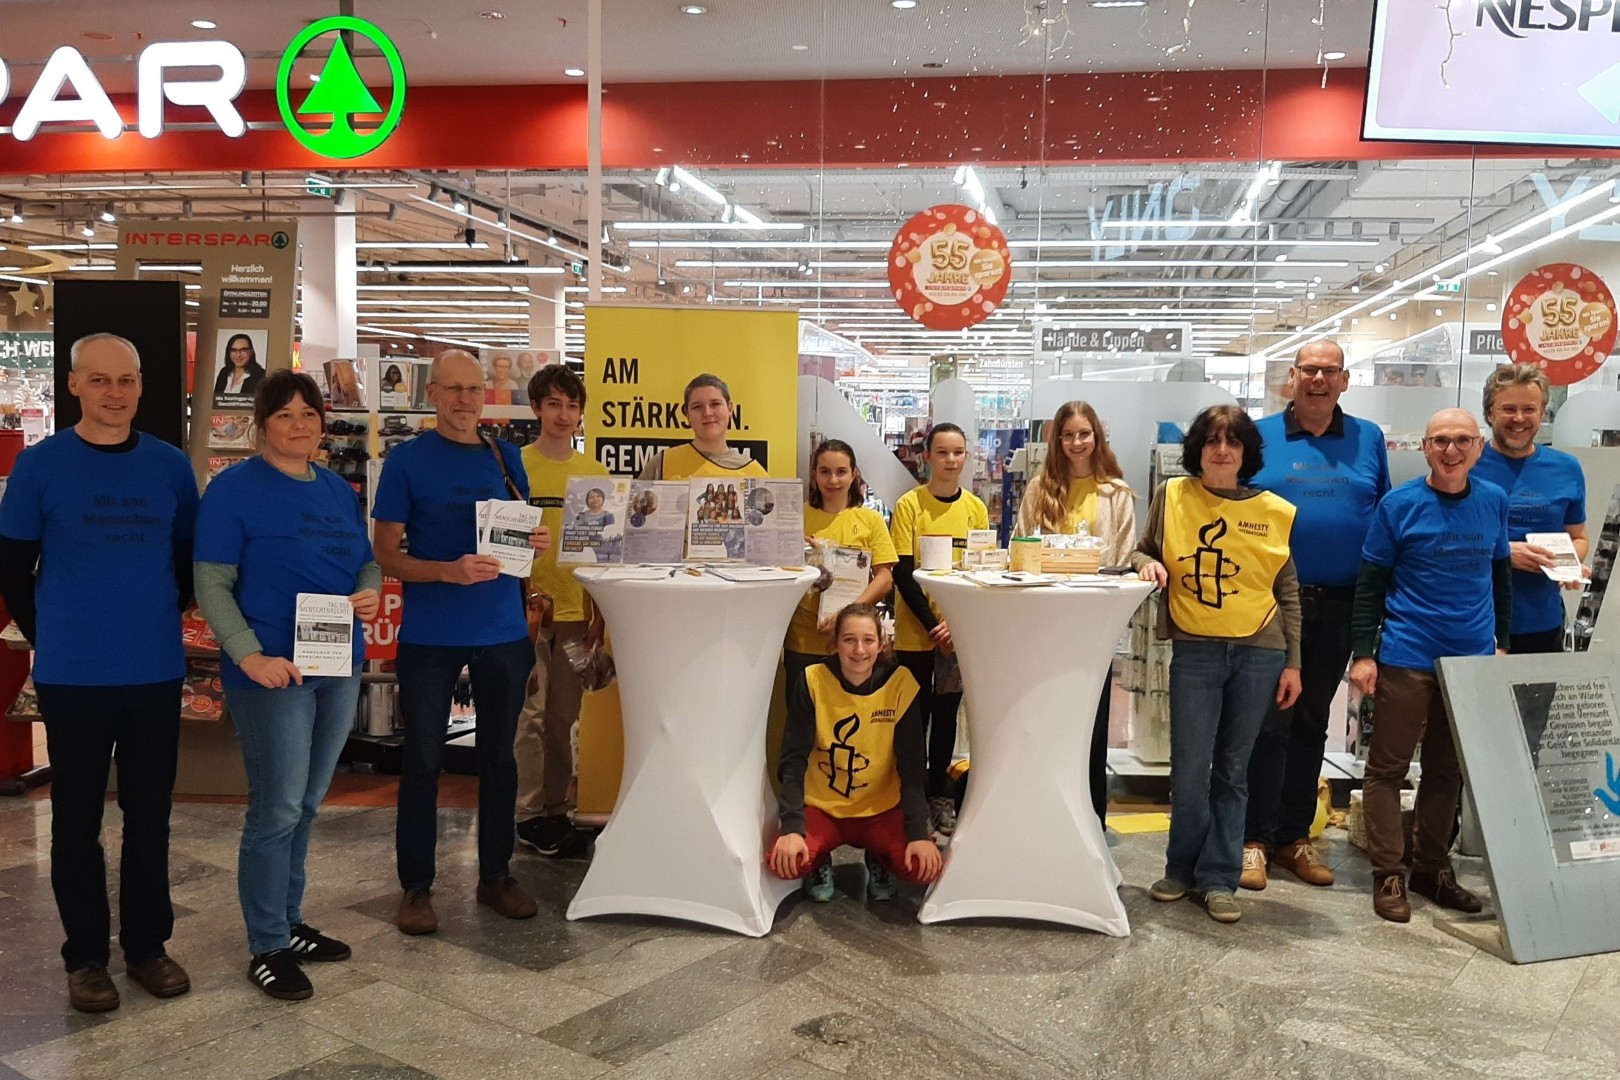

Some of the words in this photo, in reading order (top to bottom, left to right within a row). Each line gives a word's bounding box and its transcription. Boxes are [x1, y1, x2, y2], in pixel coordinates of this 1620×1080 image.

[1476, 0, 1620, 38] NESP
[0, 40, 248, 141] AR
[125, 232, 270, 247] INTERSPAR
[931, 239, 970, 270] 55
[231, 264, 265, 273] Herzlich
[974, 268, 1003, 280] sparen!
[221, 275, 273, 284] willkommen!
[926, 271, 970, 285] JAHRE
[1540, 297, 1578, 327] 55
[1583, 318, 1610, 332] sparen!
[1047, 332, 1087, 348] Hände
[1089, 333, 1100, 347] &
[1540, 327, 1580, 342] JAHRE
[1476, 334, 1506, 353] Pfle
[601, 357, 639, 385] AM
[601, 396, 749, 430] STÄRKSN.
[1302, 489, 1336, 498] recht
[93, 494, 116, 508] Mir
[121, 496, 148, 508] san
[83, 513, 161, 527] Menschen
[1238, 520, 1270, 532] AMNESTY
[105, 532, 145, 543] recht
[321, 546, 352, 556] recht
[299, 606, 350, 615] MENSCHENRECHTE
[339, 601, 350, 609] DER
[1556, 683, 1575, 692] chen
[1576, 682, 1591, 690] sind
[1593, 682, 1606, 691] frei
[1580, 691, 1604, 700] Würde
[870, 709, 897, 719] AMNESTY
[1562, 711, 1576, 720] mit
[1577, 709, 1610, 719] Vernunft
[1550, 721, 1586, 730] Gewissen
[1588, 718, 1613, 729] begabt
[1556, 729, 1578, 738] sollen
[1580, 728, 1612, 737] einander
[1547, 740, 1568, 750] Geist
[1569, 739, 1582, 748] der
